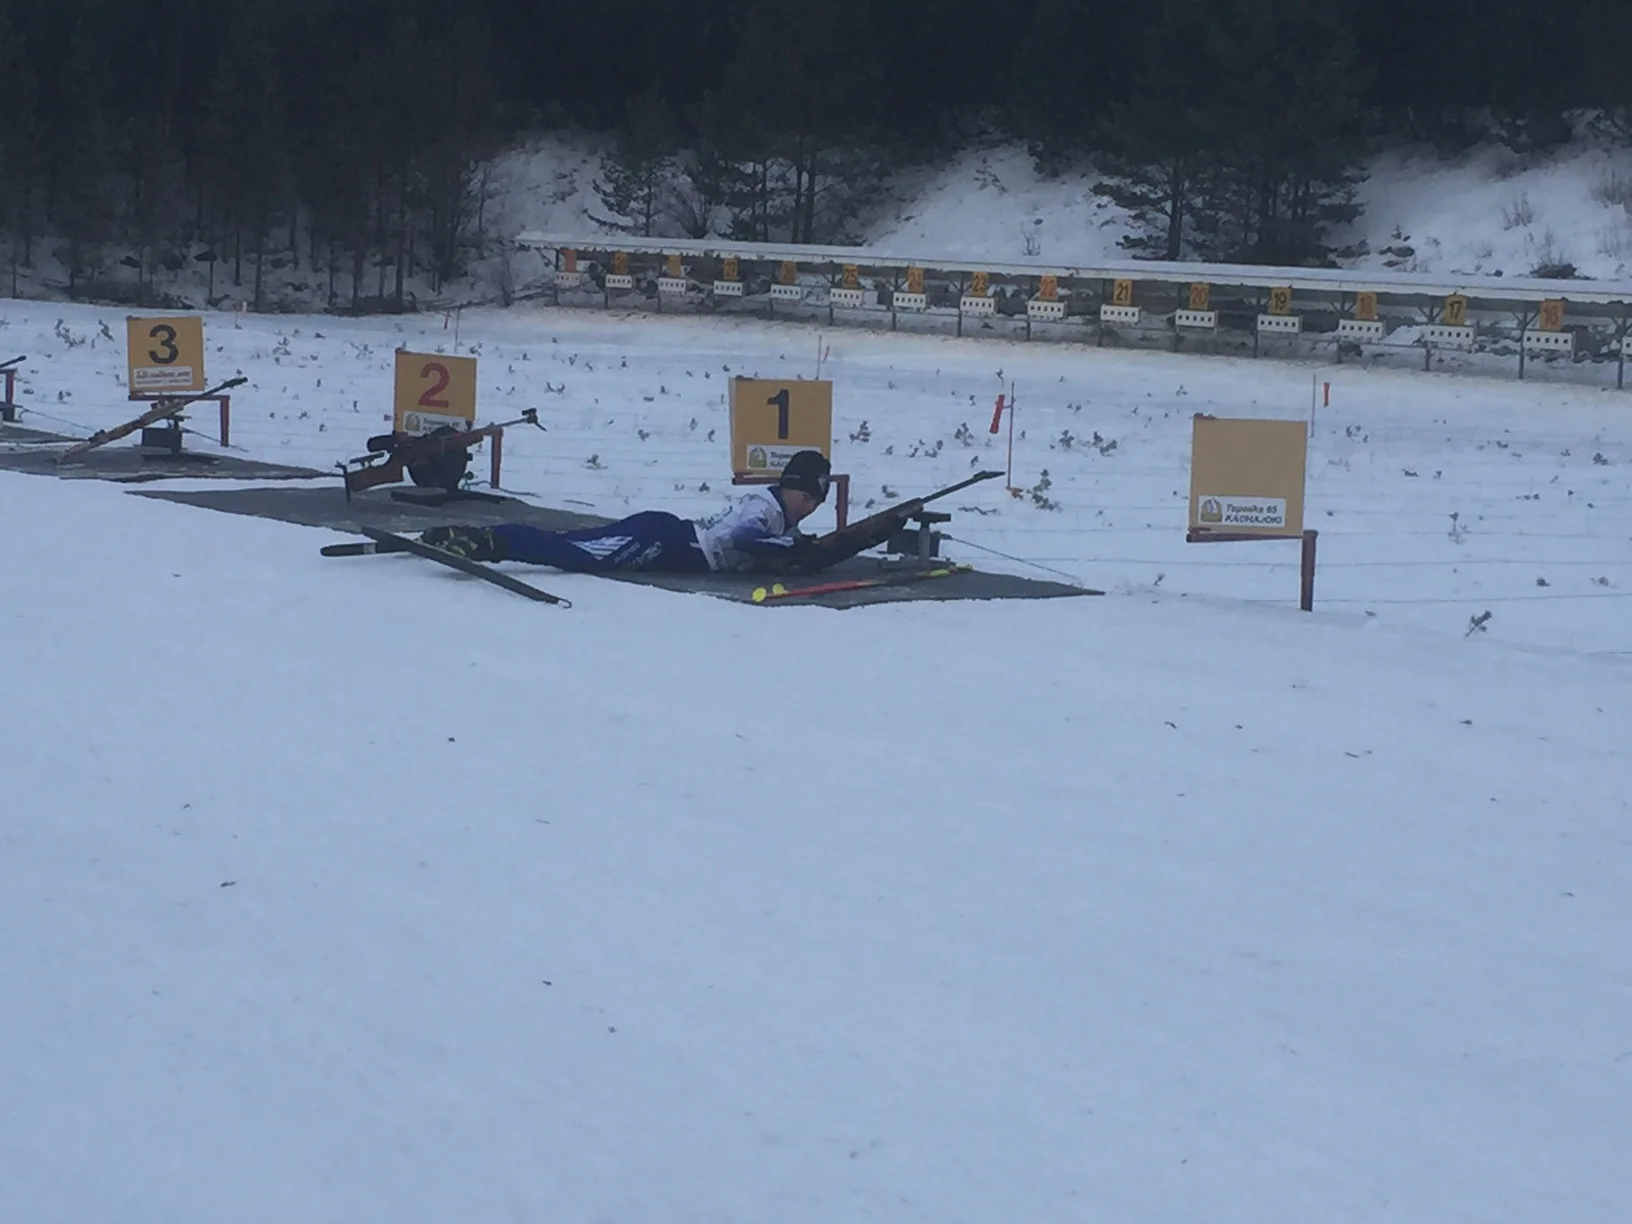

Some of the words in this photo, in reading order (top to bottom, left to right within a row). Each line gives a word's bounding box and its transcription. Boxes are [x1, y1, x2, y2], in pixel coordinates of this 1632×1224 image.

[1116, 282, 1129, 302] 21
[1192, 286, 1207, 305] 20
[1274, 291, 1287, 310] 19
[1449, 301, 1463, 320] 17
[149, 324, 179, 364] 3
[418, 362, 450, 408] 2
[767, 389, 789, 440] 1
